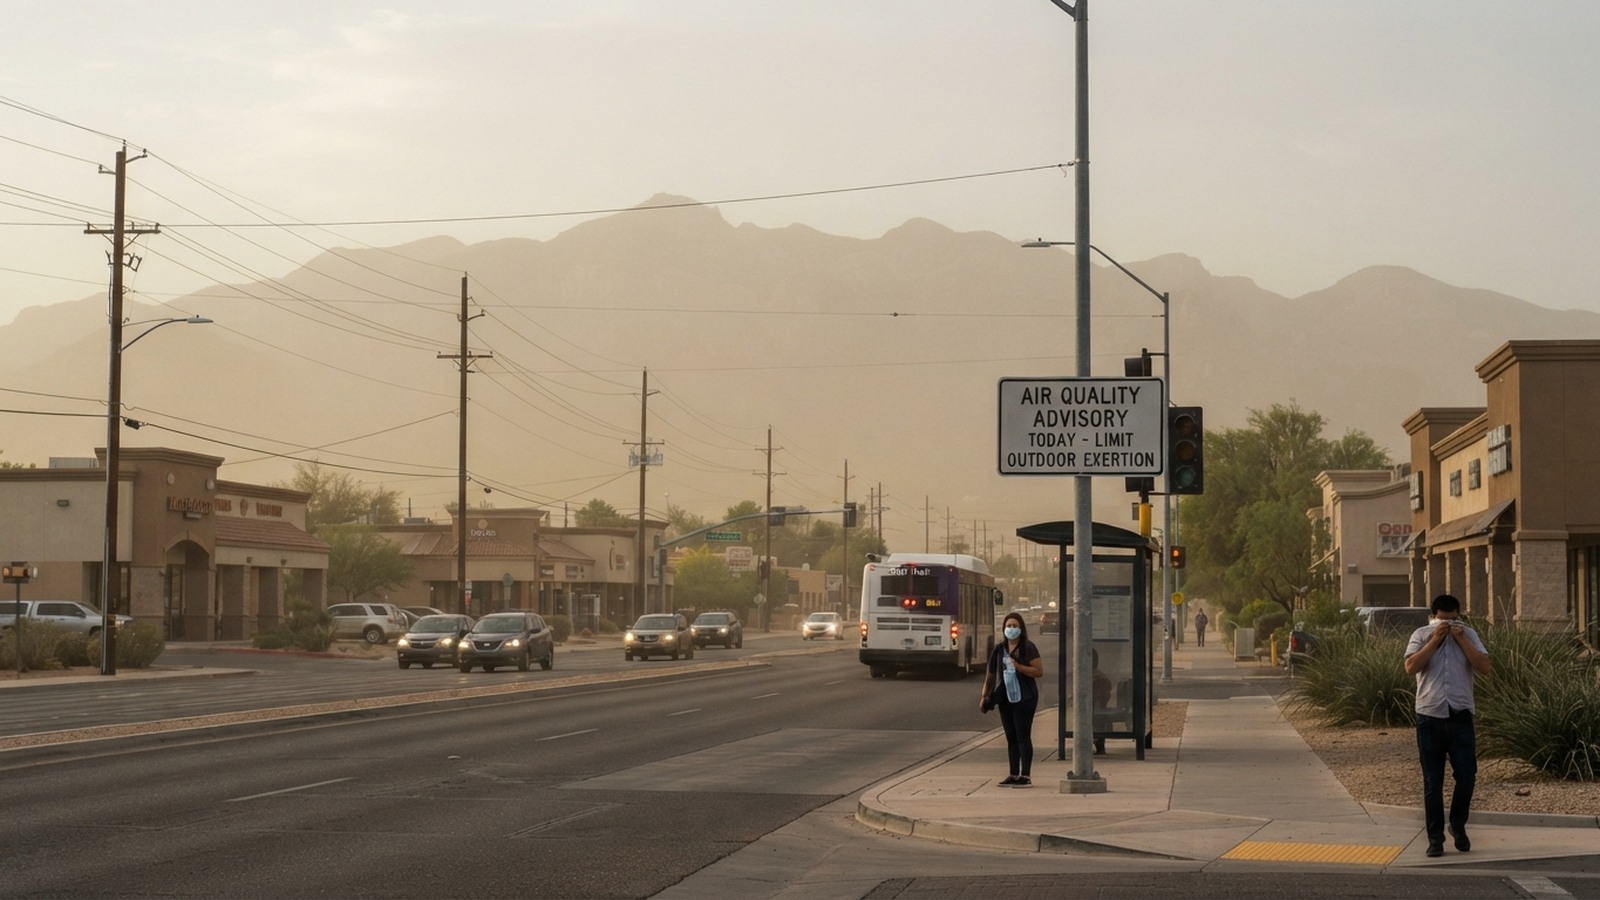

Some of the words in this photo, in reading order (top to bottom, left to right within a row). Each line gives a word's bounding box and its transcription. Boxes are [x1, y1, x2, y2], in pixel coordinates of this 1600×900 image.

[1020, 386, 1052, 406] AIR
[1061, 386, 1141, 405] QUALITY
[1033, 409, 1129, 428] ADVISORY
[1028, 432, 1076, 448] TODAY
[1096, 432, 1134, 448] LIMIT
[1007, 452, 1076, 468] OUTDOOR
[1083, 452, 1155, 468] EXERTION
